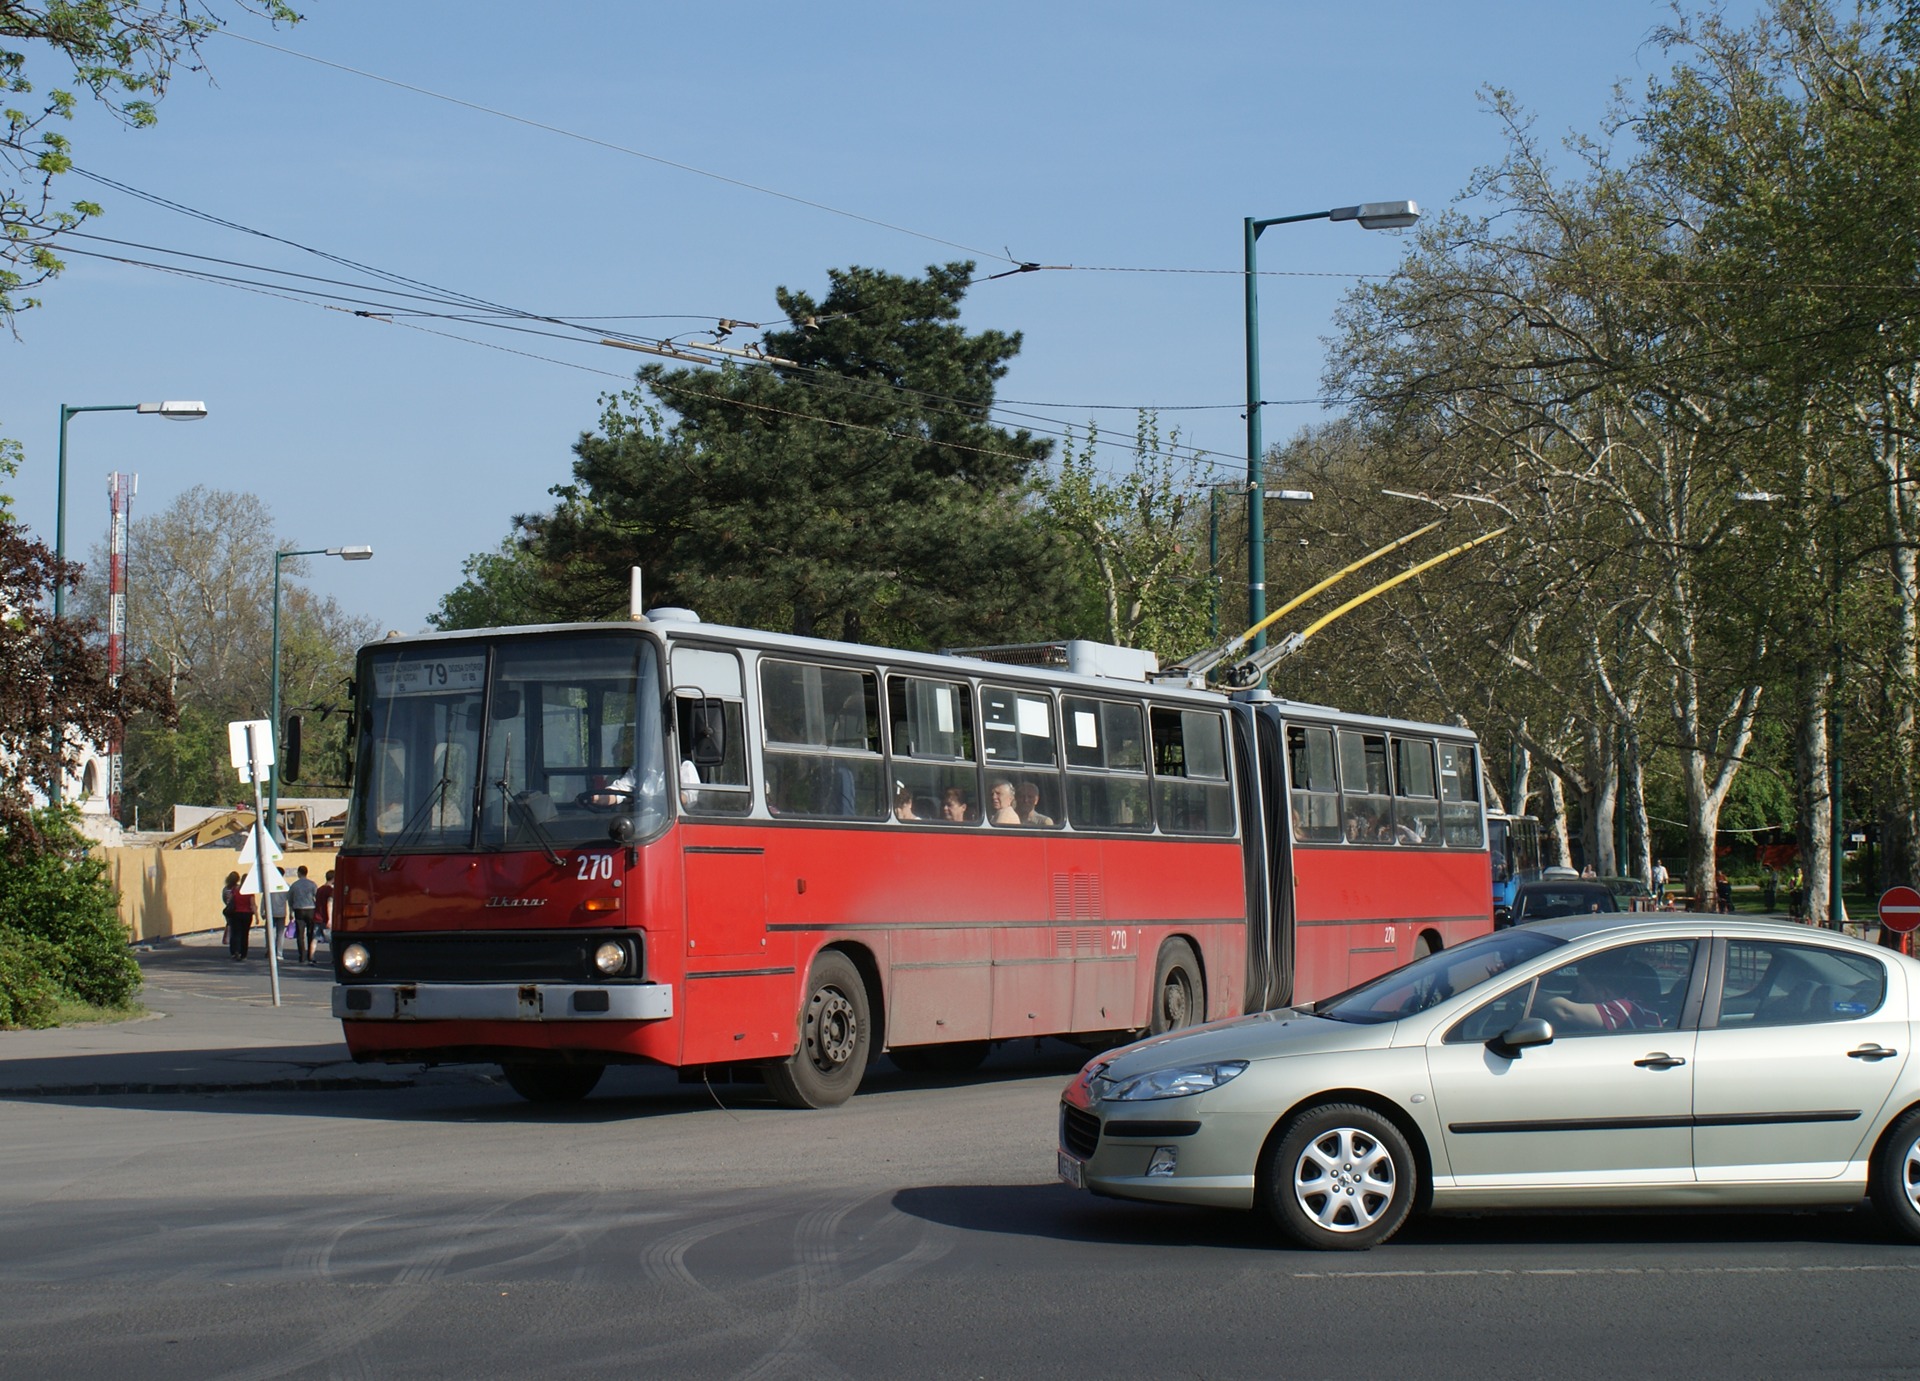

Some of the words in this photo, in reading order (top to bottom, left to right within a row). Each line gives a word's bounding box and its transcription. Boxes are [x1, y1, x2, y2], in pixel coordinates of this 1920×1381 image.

[424, 663, 448, 686] 79
[577, 855, 613, 880] 270
[1111, 930, 1127, 950] 270
[1384, 926, 1395, 943] 270
